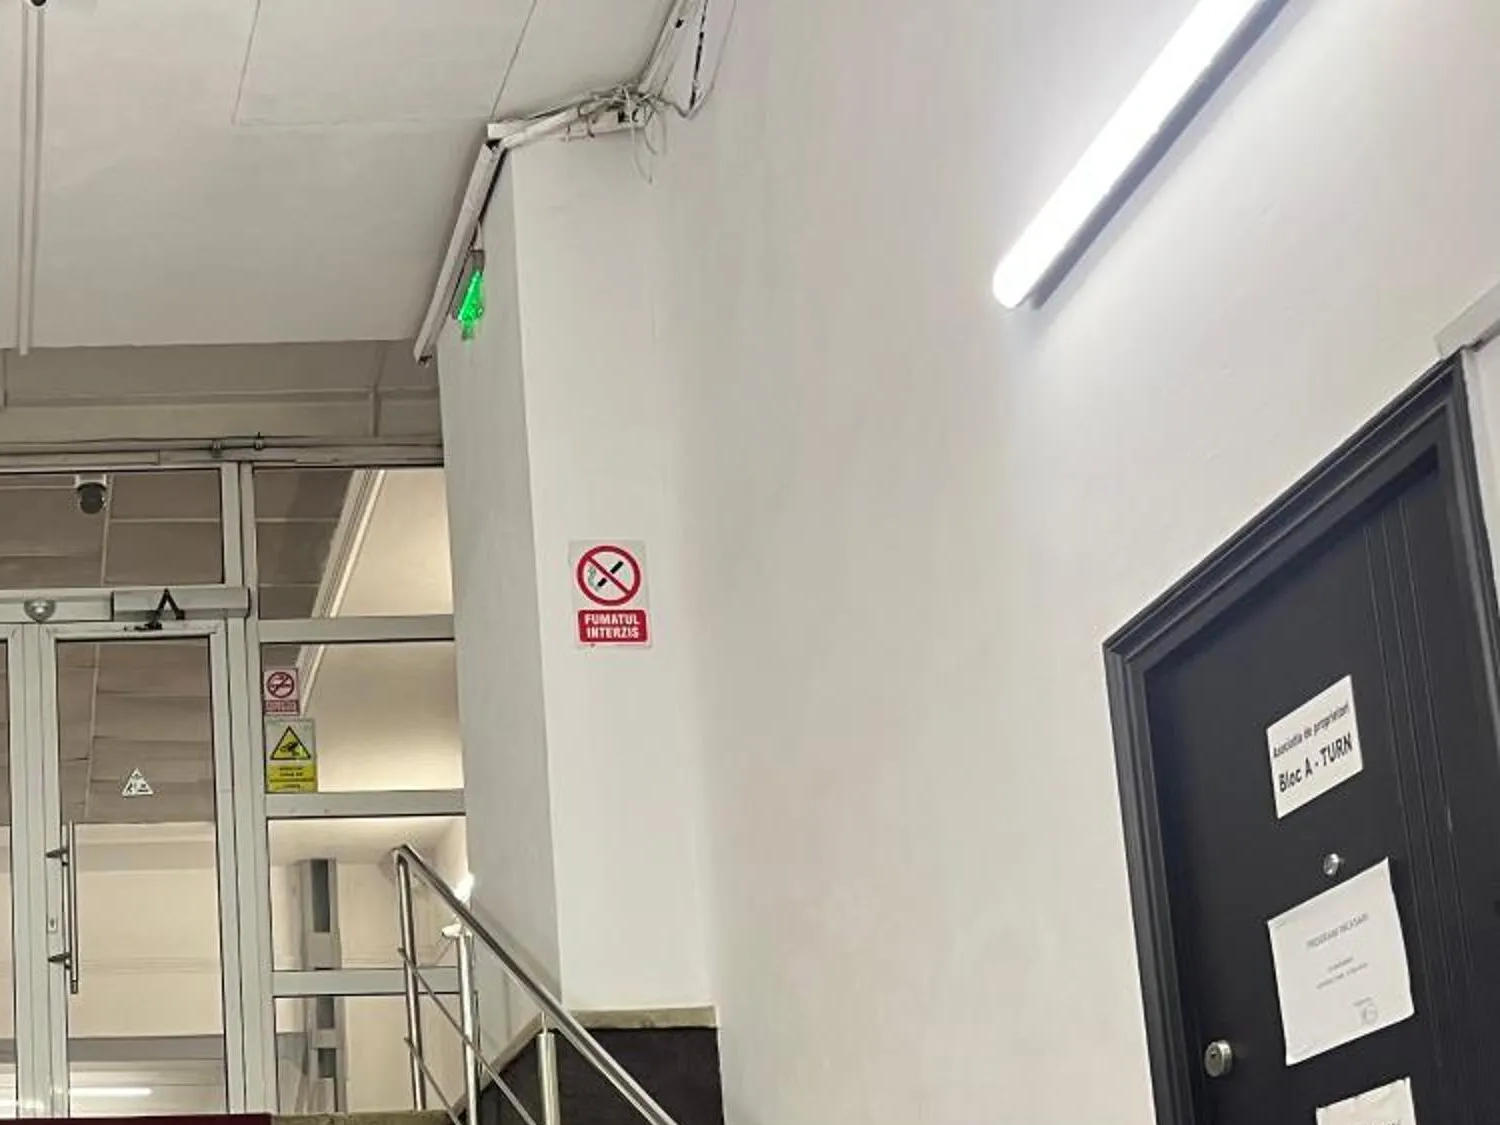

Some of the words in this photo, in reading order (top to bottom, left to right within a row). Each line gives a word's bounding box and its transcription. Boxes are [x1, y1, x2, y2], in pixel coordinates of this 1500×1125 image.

[584, 613, 640, 625] FUMATUL
[587, 626, 639, 639] INTERZIS
[1278, 769, 1302, 793] Bloc
[1304, 756, 1313, 778] A
[1319, 731, 1353, 767] TURN
